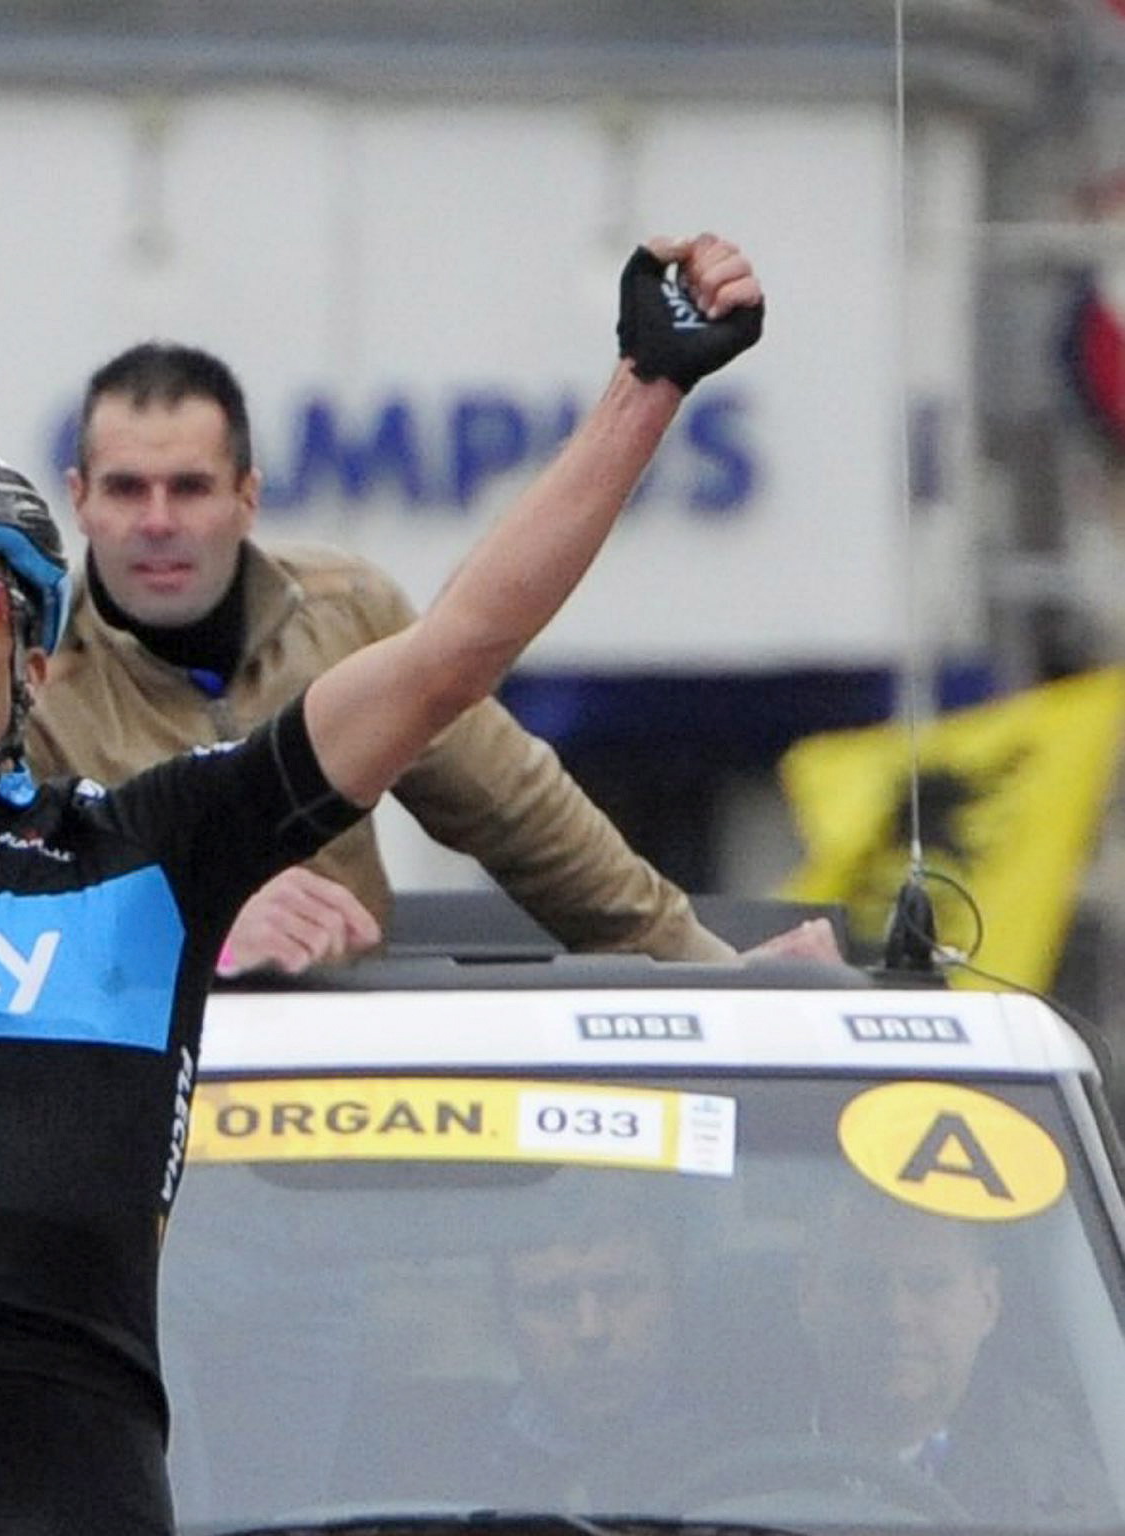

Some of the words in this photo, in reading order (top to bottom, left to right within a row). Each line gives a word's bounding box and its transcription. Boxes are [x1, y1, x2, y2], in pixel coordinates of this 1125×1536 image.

[585, 1014, 695, 1040] BASE
[851, 1016, 963, 1042] BASE
[536, 1106, 640, 1138] 033
[897, 1110, 1016, 1202] A
